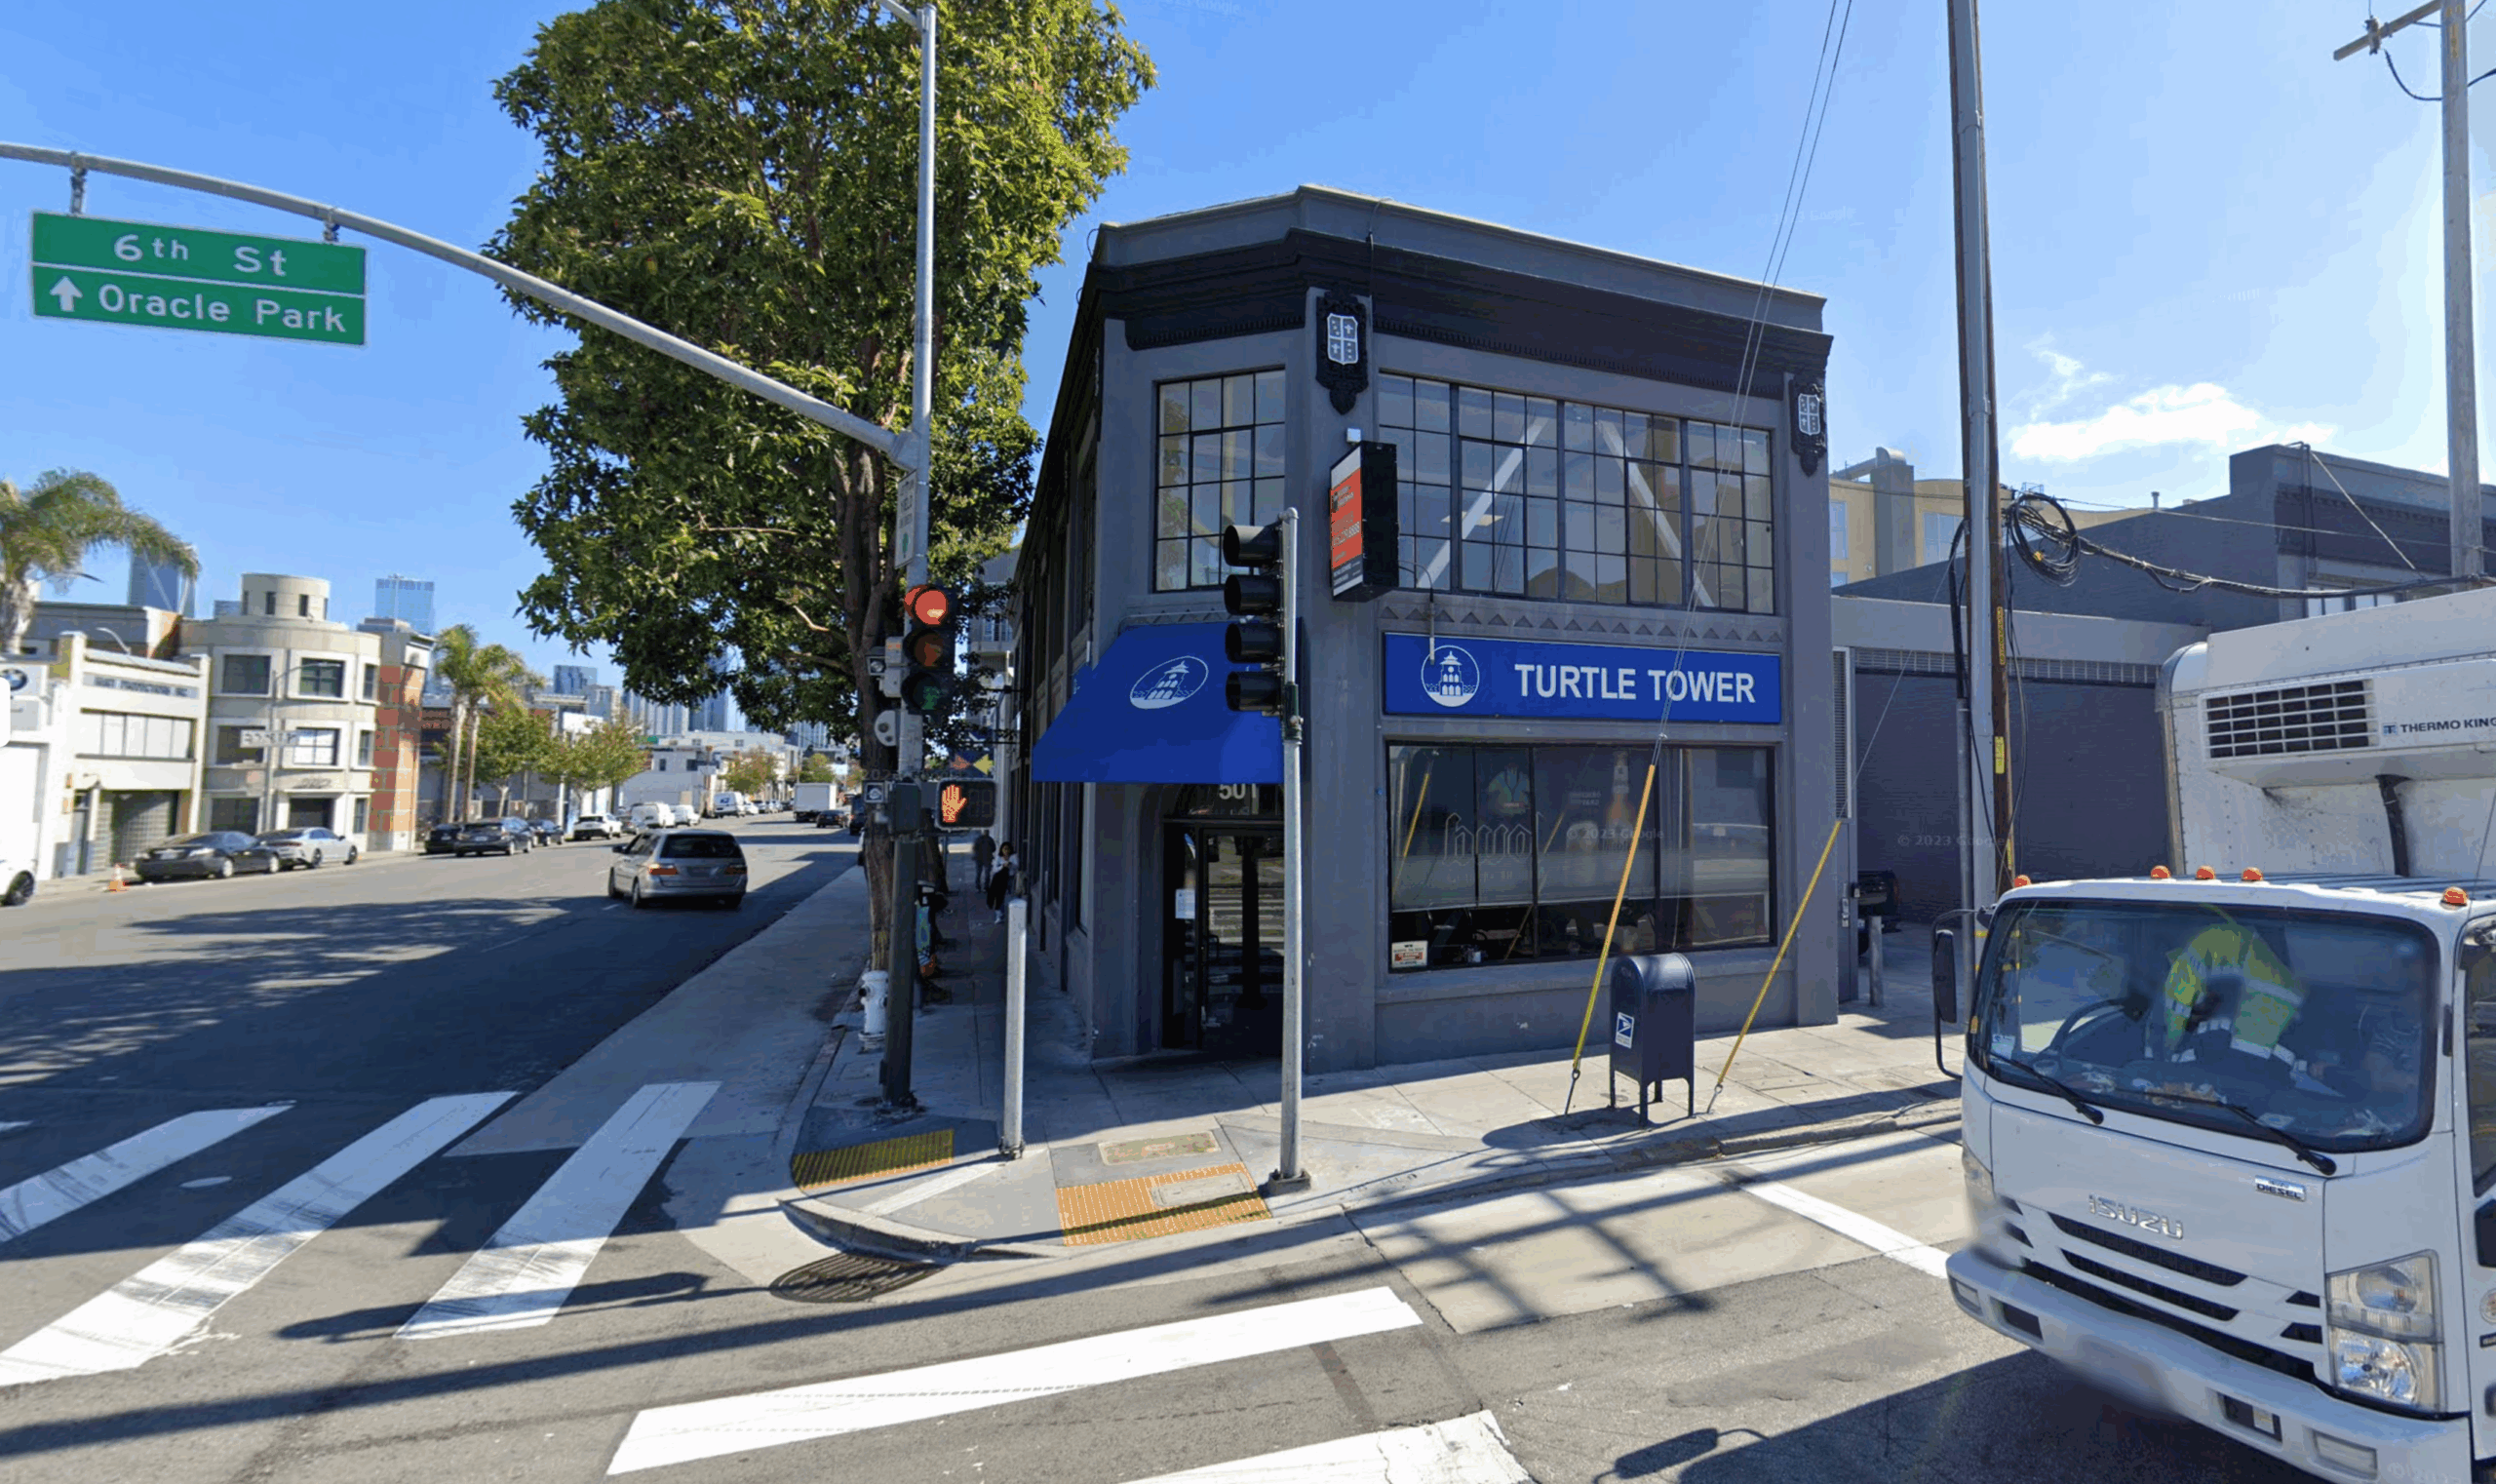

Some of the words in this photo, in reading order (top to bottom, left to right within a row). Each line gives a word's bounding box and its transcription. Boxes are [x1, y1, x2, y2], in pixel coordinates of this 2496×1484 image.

[113, 234, 189, 261] 6th
[233, 246, 287, 277] St
[98, 284, 230, 323] Oracle
[255, 298, 346, 332] Park
[1514, 664, 1637, 700] TURTLE
[1648, 669, 1756, 704] TOWER
[2400, 720, 2462, 733] THERMO
[1219, 783, 1257, 801] 501
[2256, 1183, 2301, 1200] DIESEL
[2088, 1192, 2184, 1240] ISUZU
